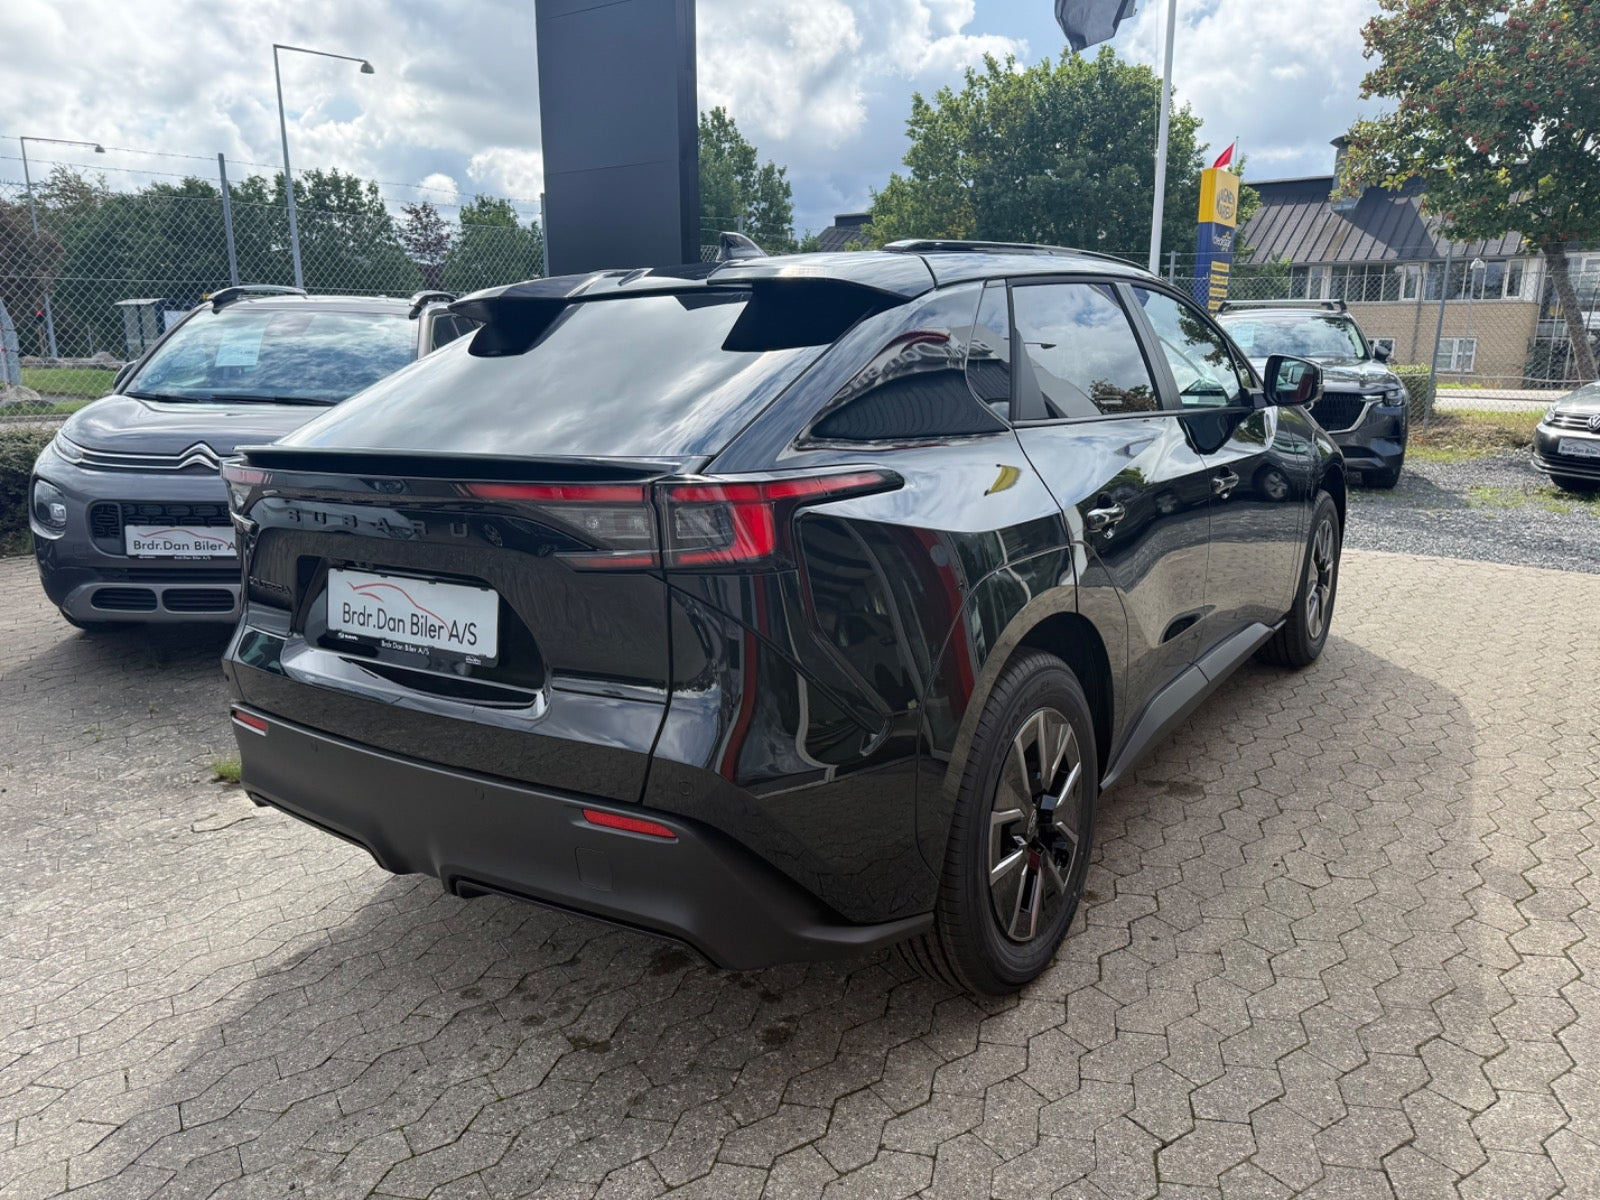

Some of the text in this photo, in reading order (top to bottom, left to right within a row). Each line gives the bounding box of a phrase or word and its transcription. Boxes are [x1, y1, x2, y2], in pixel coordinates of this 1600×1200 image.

[133, 540, 190, 551] Brdr.Dan
[194, 540, 224, 551] Biler
[343, 602, 478, 646] Brdr.Dan Biler A/S
